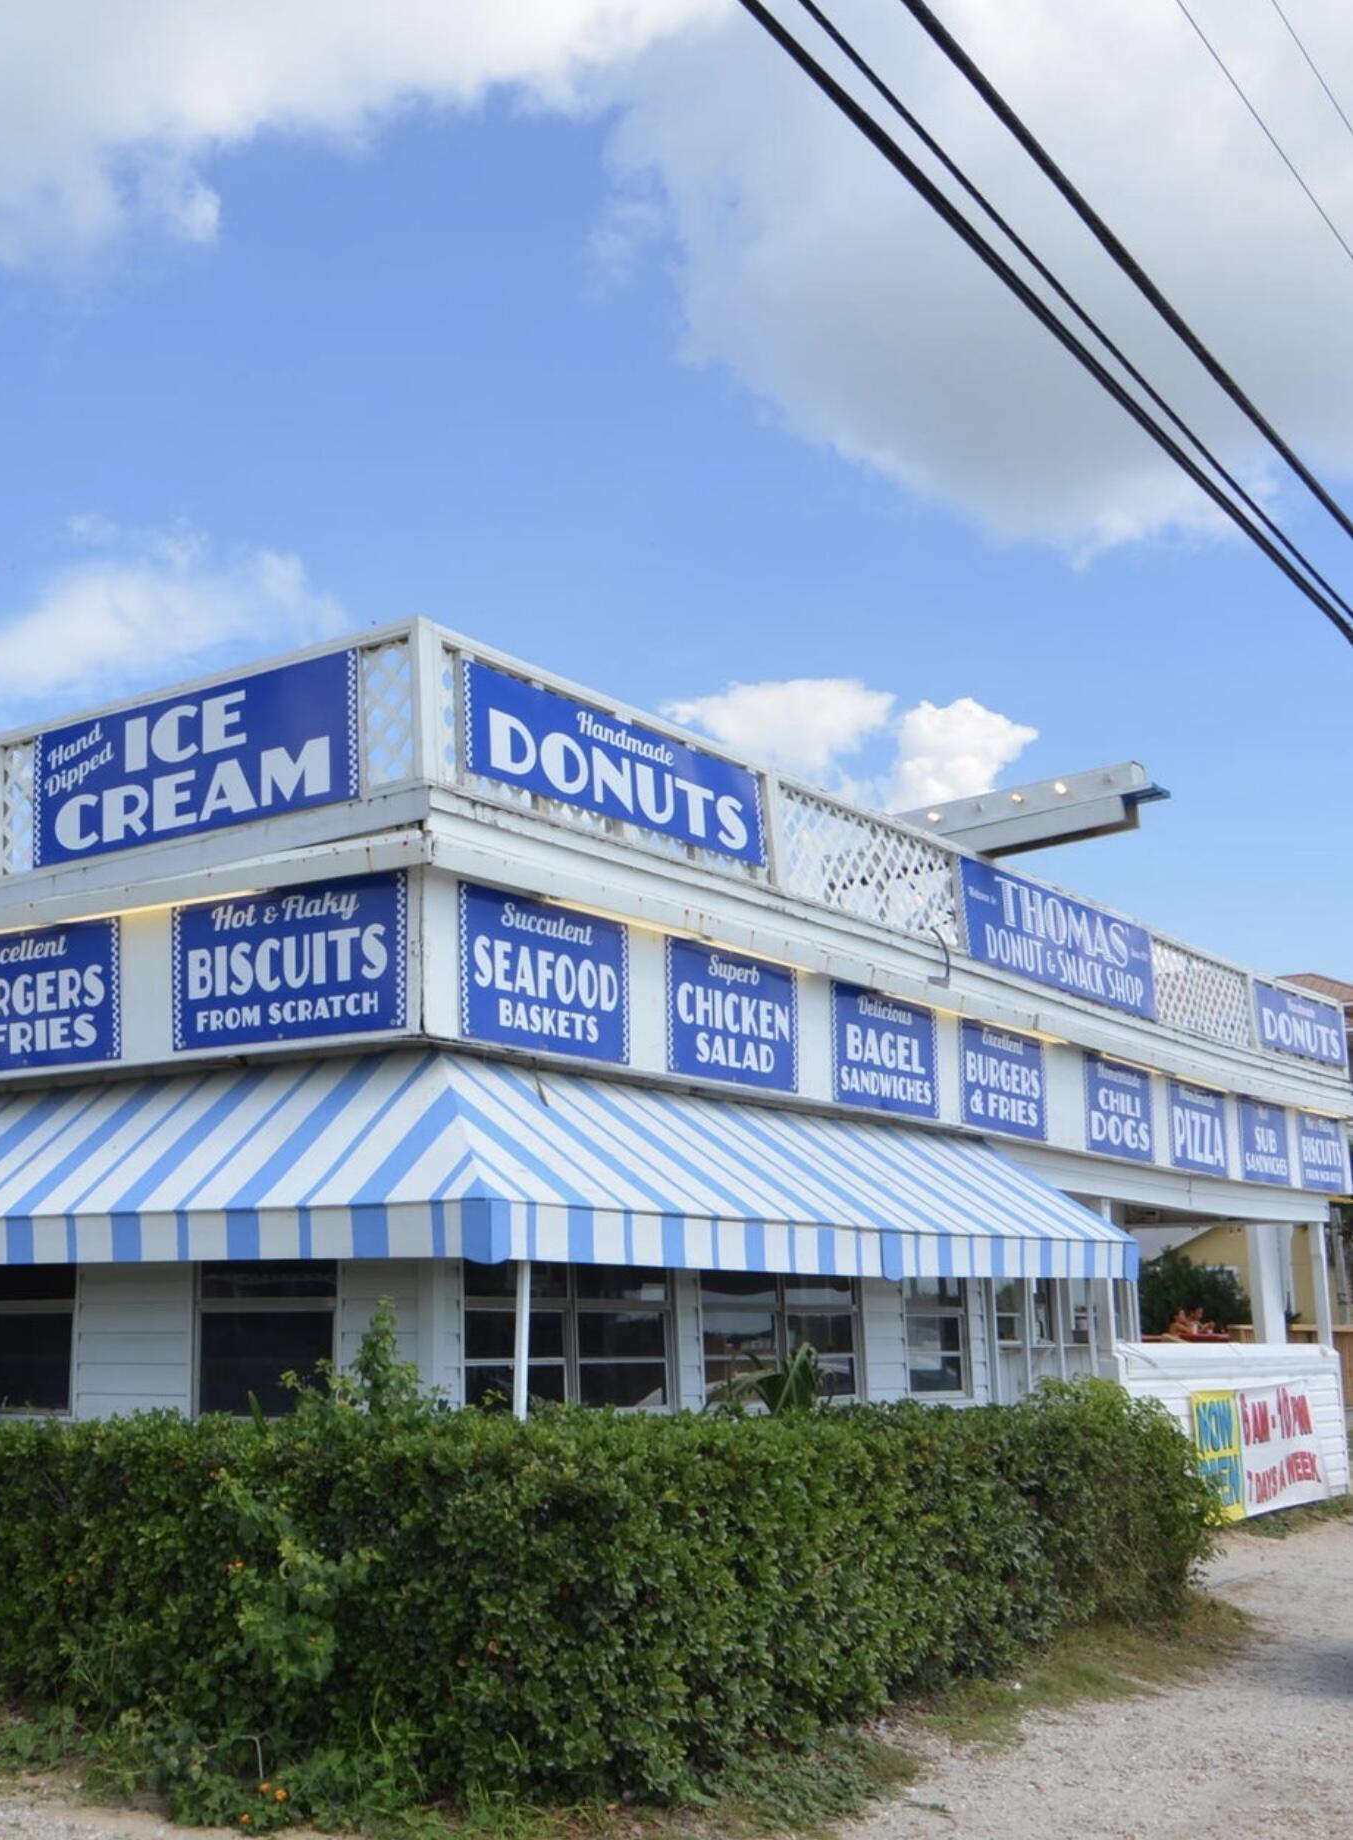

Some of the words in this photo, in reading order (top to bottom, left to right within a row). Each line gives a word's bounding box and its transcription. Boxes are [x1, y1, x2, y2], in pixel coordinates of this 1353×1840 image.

[47, 722, 104, 770] Hand
[125, 689, 247, 774] ICE
[576, 711, 676, 767] Handmade
[45, 741, 114, 799] Dipped
[54, 736, 331, 851] CREAM
[489, 707, 748, 850] DONUTS
[211, 902, 257, 932] Hot
[263, 907, 277, 924] &
[281, 892, 359, 923] Flaky
[501, 902, 593, 947] Succulent
[188, 922, 389, 1000] BISCUITS
[474, 934, 619, 1013] SEAFOOD
[708, 954, 761, 988] Superb
[985, 922, 1045, 976] DONUT
[1047, 952, 1056, 974] &
[1057, 949, 1106, 997] SNACK
[1108, 968, 1144, 1007] SHOP
[196, 1004, 262, 1033] FROM
[268, 990, 379, 1025] SCRATCH
[499, 999, 599, 1044] BASKETS
[677, 982, 791, 1043] CHICKEN
[857, 995, 913, 1026] Delicious
[1262, 1007, 1341, 1060] DONUTS
[696, 1031, 775, 1074] SALAD
[846, 1023, 926, 1075] BAGEL
[840, 1065, 932, 1106] SANDWICHES
[965, 1050, 1042, 1100] BURGERS
[969, 1089, 985, 1116] &
[987, 1091, 1038, 1128] FRIES
[1098, 1087, 1141, 1119] CHILI
[1090, 1109, 1150, 1152] DOGS
[1173, 1105, 1225, 1169] PIZZA
[1254, 1125, 1278, 1154] SUB
[1196, 1398, 1233, 1453] NOW
[1255, 1466, 1278, 1505] DAYS
[1286, 1451, 1322, 1486] WEEK
